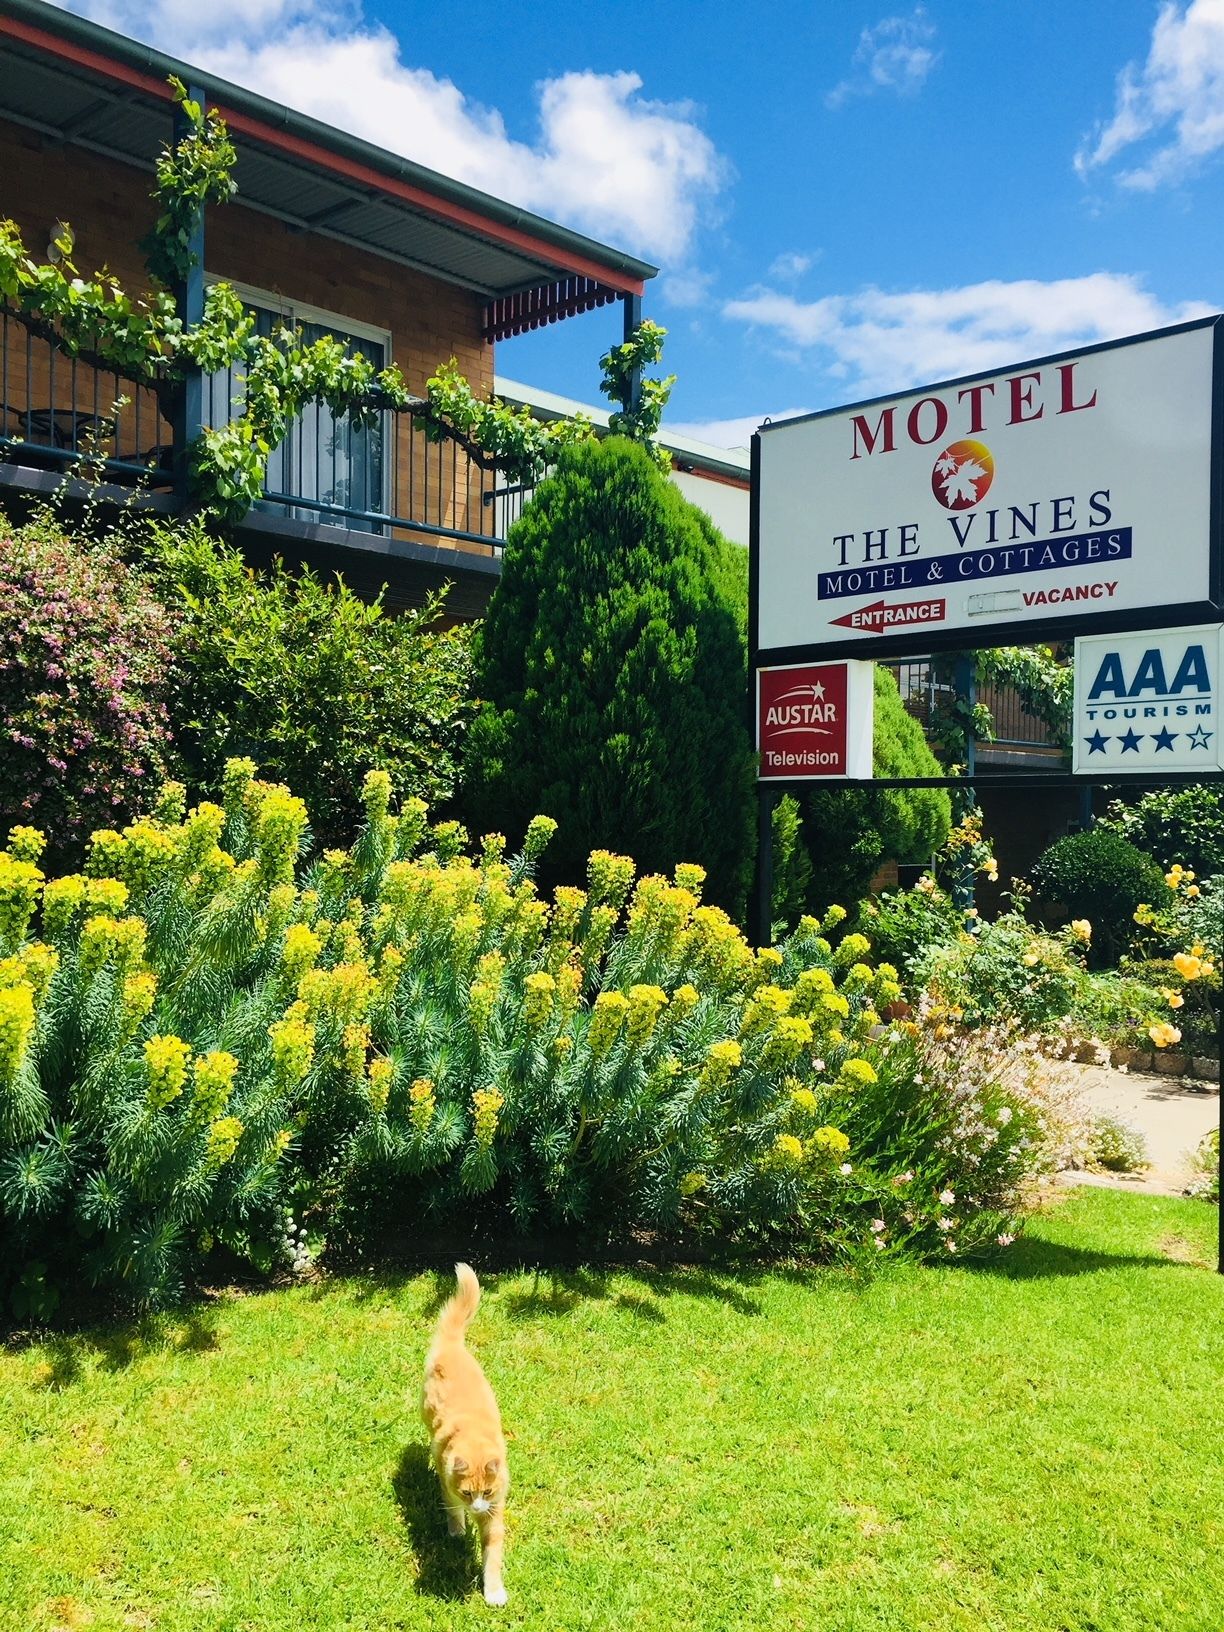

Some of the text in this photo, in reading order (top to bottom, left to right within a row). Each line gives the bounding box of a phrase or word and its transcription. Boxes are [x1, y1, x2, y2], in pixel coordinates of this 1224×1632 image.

[849, 362, 1098, 460] MOTEL
[833, 489, 1112, 566] THE VINES
[825, 533, 1122, 595] MOTEL & COTTAGES
[1022, 581, 1118, 607] VACANCY
[851, 603, 941, 628] ENTRANCE
[1087, 645, 1211, 699] AAA
[766, 703, 836, 726] AUSTAR
[1086, 704, 1212, 720] TOURISM
[766, 749, 839, 767] Television
